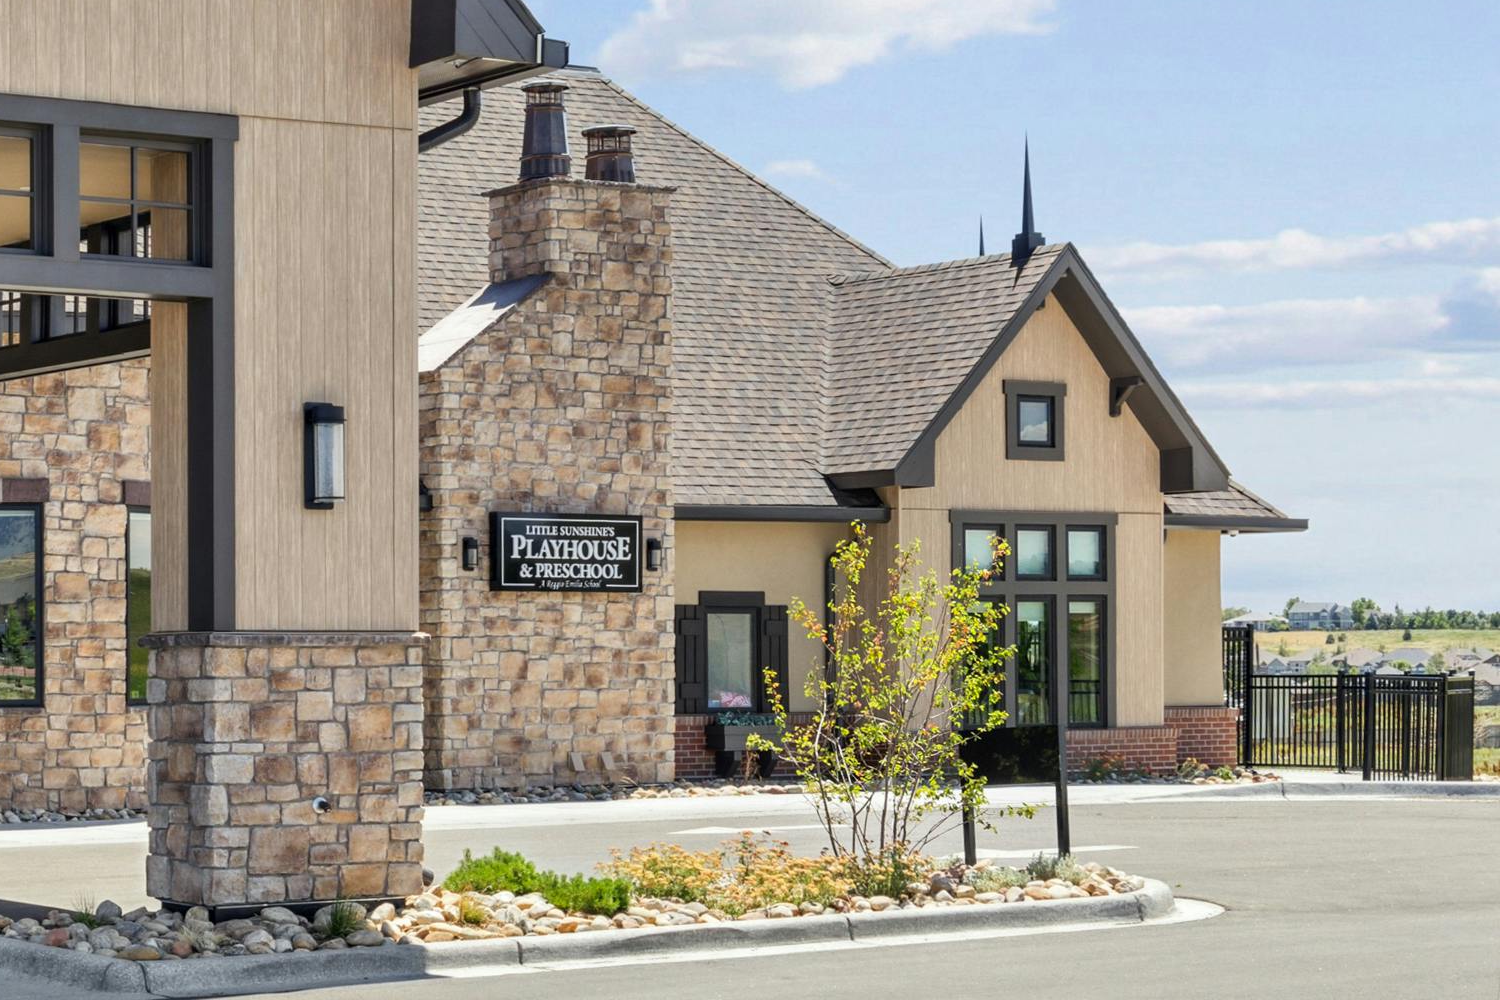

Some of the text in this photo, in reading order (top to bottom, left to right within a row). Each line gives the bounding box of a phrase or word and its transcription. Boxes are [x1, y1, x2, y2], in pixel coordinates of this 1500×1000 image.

[526, 525, 615, 537] LITTLE SUNSHINE'S
[510, 535, 632, 560] PLAYHOUSE
[519, 563, 623, 579] & PRESCHOOL
[583, 580, 602, 589] School
